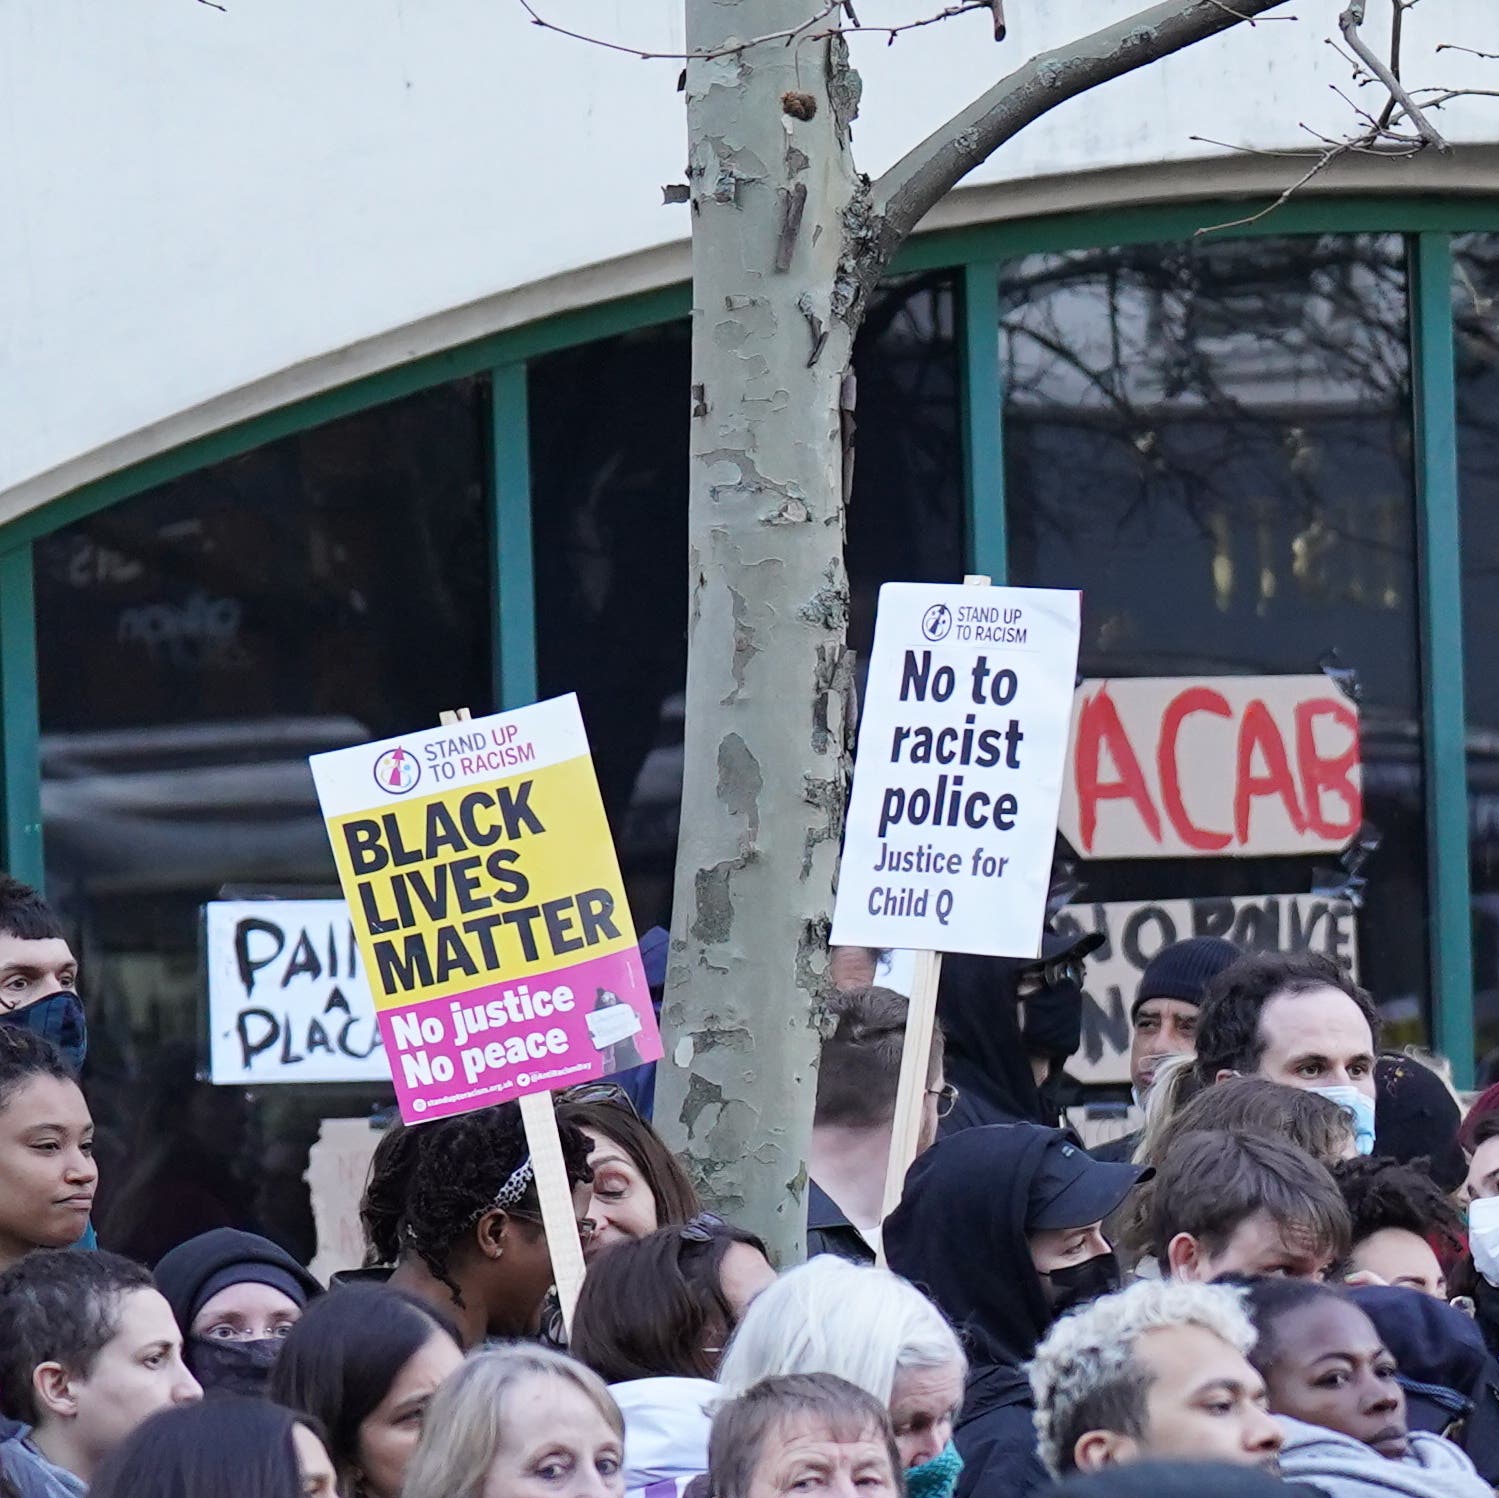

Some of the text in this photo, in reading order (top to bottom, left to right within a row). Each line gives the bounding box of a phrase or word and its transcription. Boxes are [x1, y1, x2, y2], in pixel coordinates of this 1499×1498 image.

[956, 624, 1027, 644] TO RACISM
[957, 606, 1022, 625] STAND UP
[899, 650, 1018, 706] No to
[424, 724, 519, 762] STAND UP
[429, 741, 536, 783] TO RACISM
[890, 714, 1024, 769] racist
[1074, 680, 1363, 853] ACAB
[342, 779, 546, 876] BLACK
[878, 774, 1018, 838] police
[874, 842, 1009, 878] Justice for
[358, 848, 530, 935] LIVES
[868, 886, 953, 926] Child Q
[373, 888, 622, 995] MATTER
[324, 986, 350, 1014] A
[390, 985, 576, 1050] No justice
[400, 1027, 569, 1089] No peace
